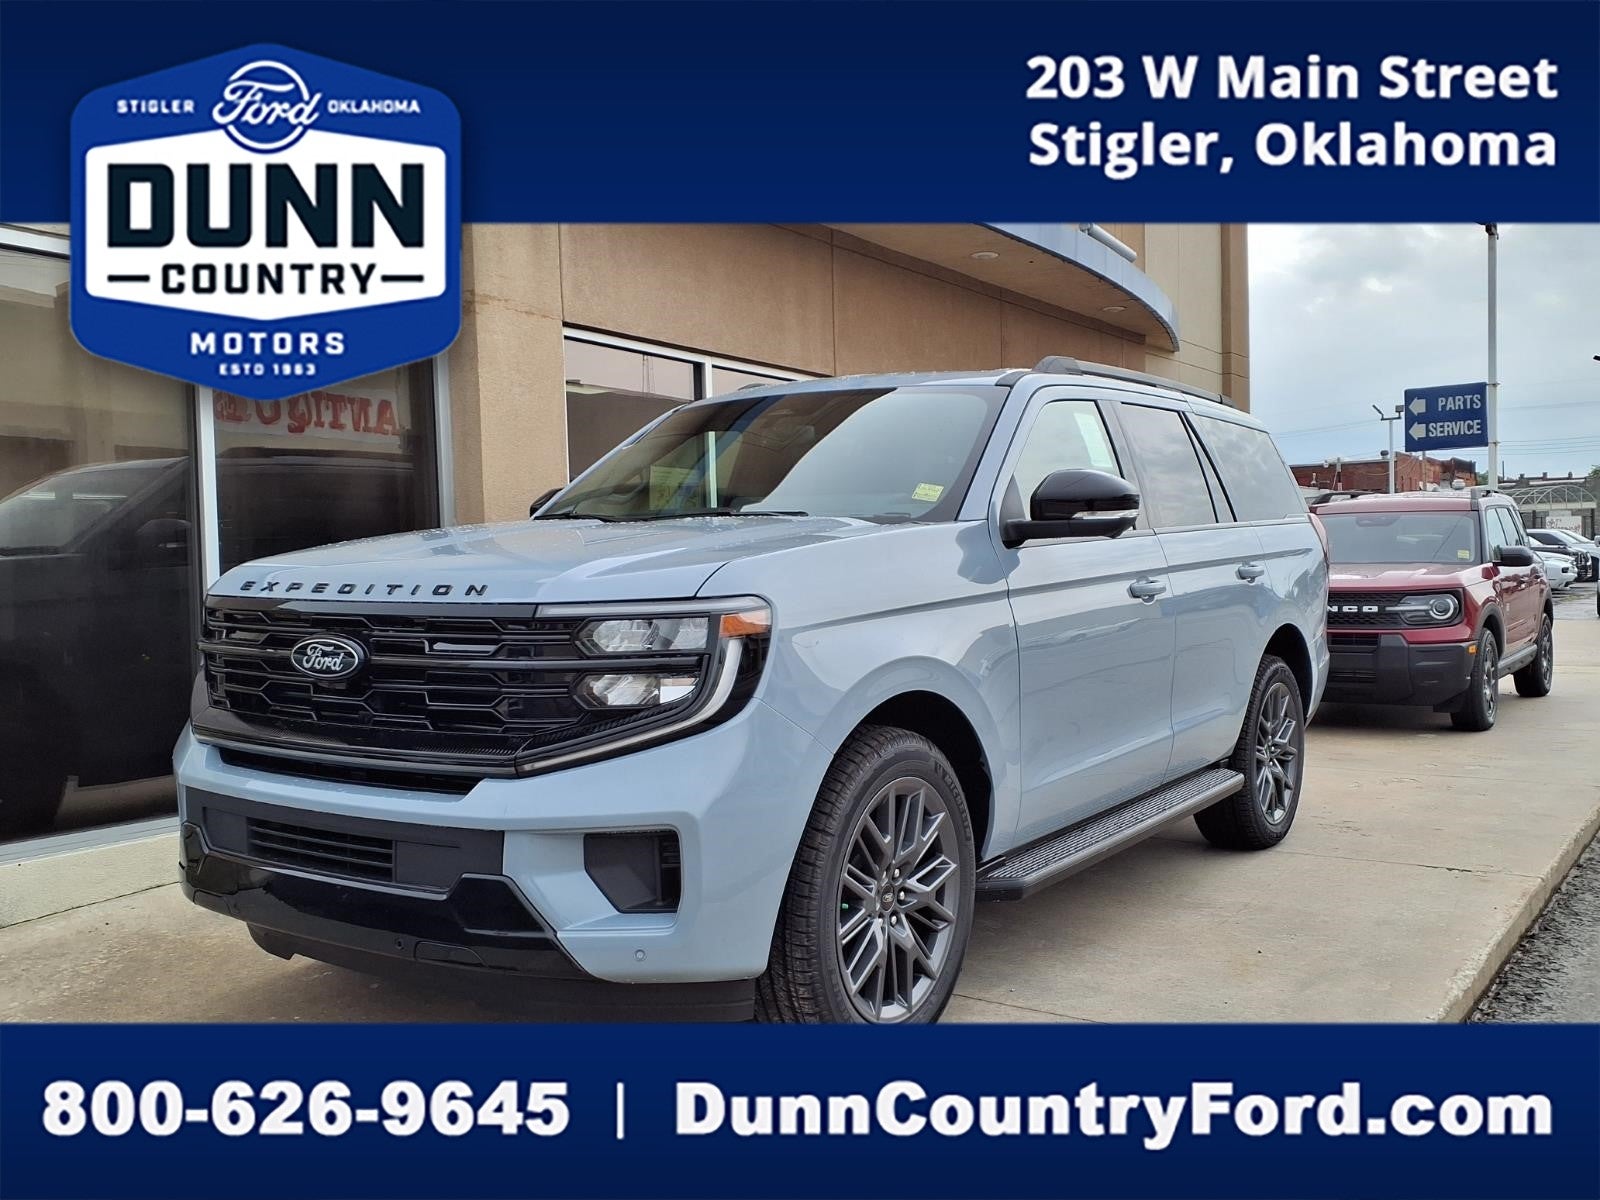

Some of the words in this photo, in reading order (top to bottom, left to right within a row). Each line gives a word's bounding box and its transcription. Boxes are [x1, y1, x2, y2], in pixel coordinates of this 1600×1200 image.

[1438, 394, 1481, 411] PARTS
[1428, 419, 1482, 437] SERVICE
[239, 580, 489, 597] EXPEDITION
[303, 643, 345, 671] Ford
